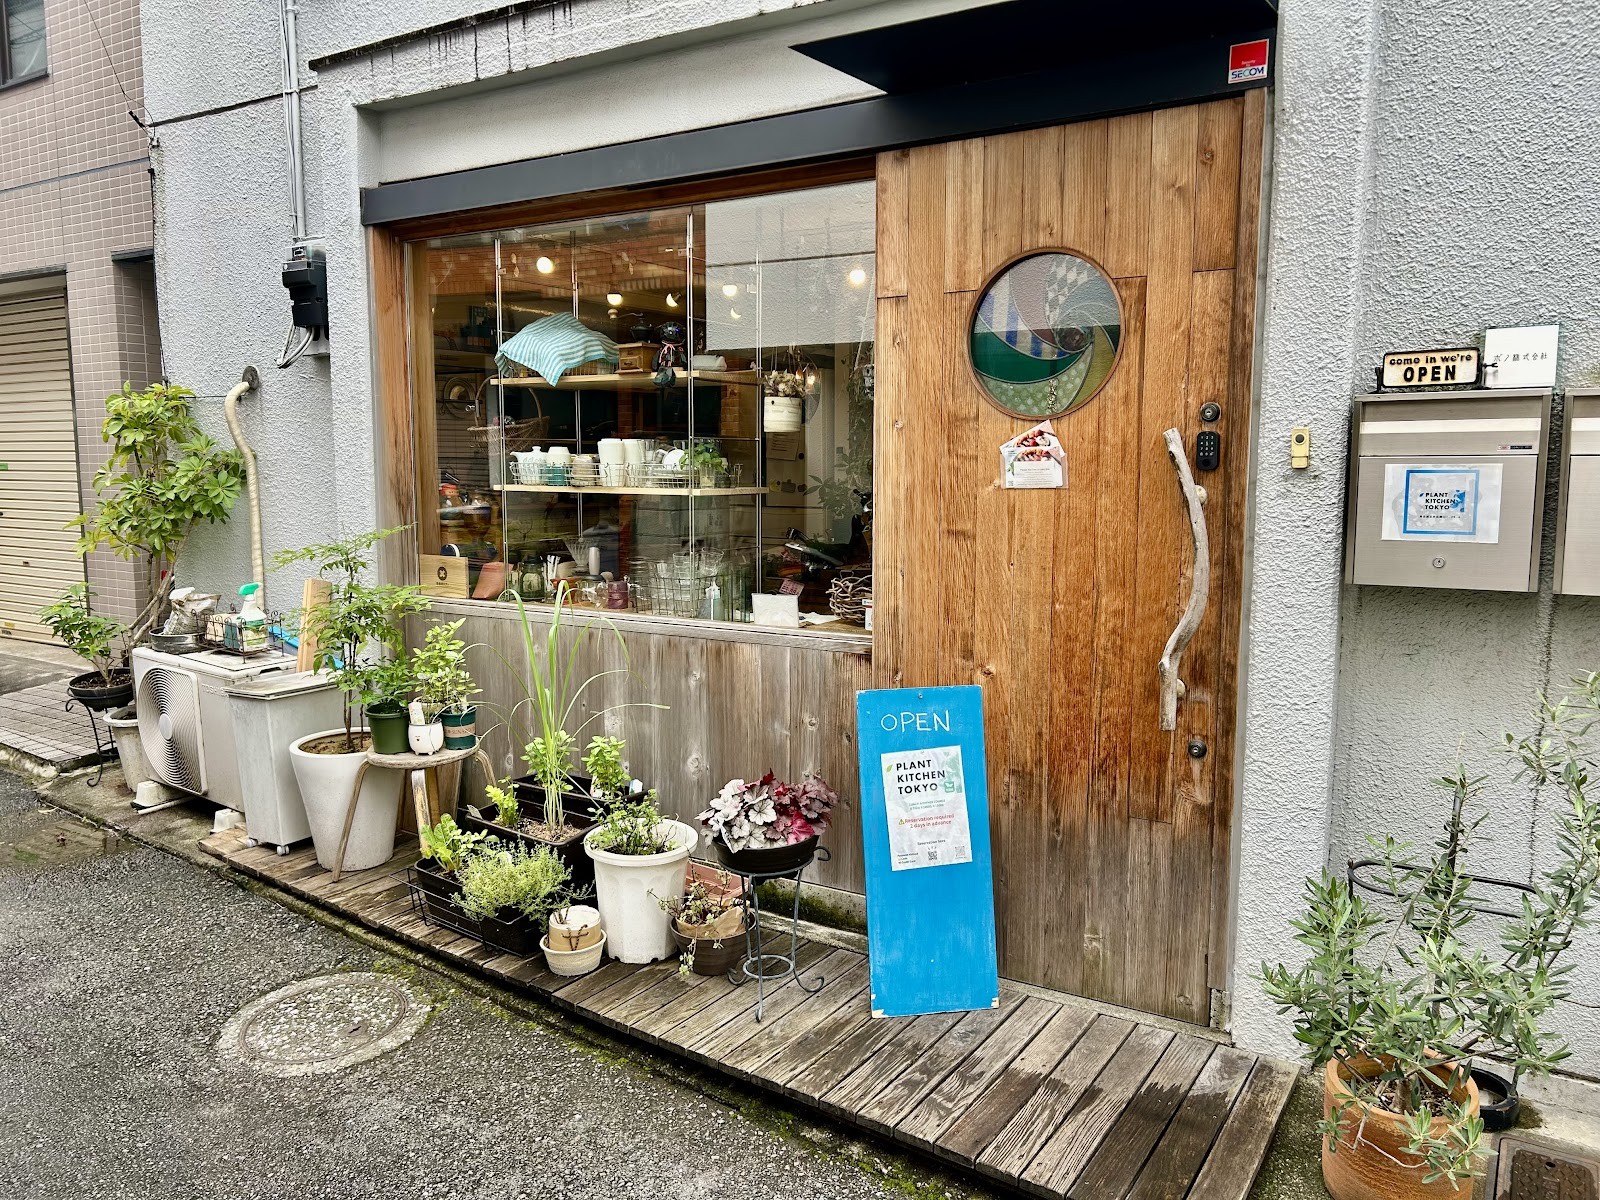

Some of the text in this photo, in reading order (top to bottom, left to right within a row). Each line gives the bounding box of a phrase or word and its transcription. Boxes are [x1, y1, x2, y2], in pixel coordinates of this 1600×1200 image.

[1231, 66, 1264, 79] SECOM
[1389, 353, 1472, 366] come in we're
[1403, 364, 1457, 383] OPEN
[880, 709, 950, 733] OPEN
[896, 759, 931, 771] PLANT
[897, 770, 946, 783] KITCHEN
[898, 783, 938, 795] TOKYO
[905, 816, 933, 824] Reservation
